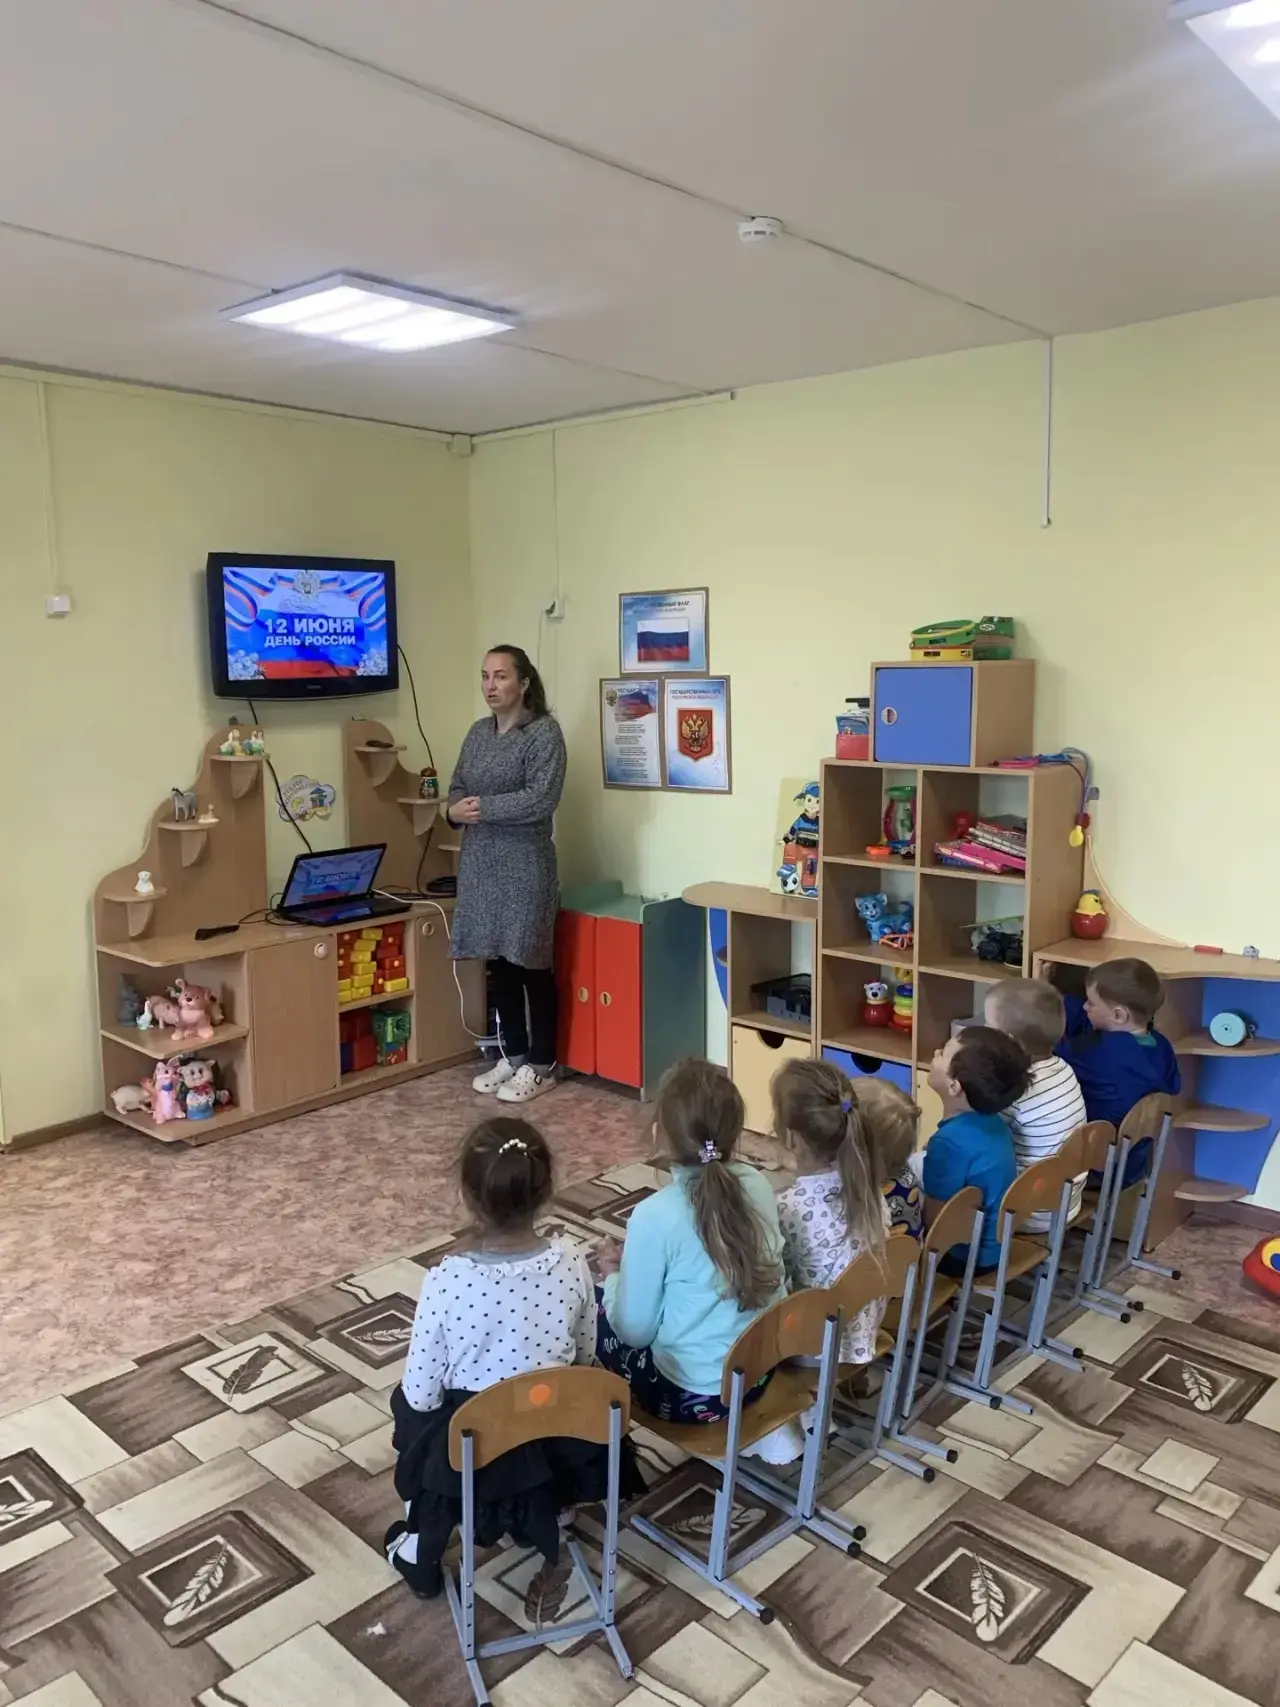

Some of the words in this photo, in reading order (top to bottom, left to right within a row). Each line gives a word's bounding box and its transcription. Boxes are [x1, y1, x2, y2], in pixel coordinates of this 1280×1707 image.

[264, 618, 288, 634] 12
[294, 617, 355, 634] ИЮНЯ
[264, 635, 301, 648] ДЕНЬ
[304, 635, 356, 646] РОССИИ
